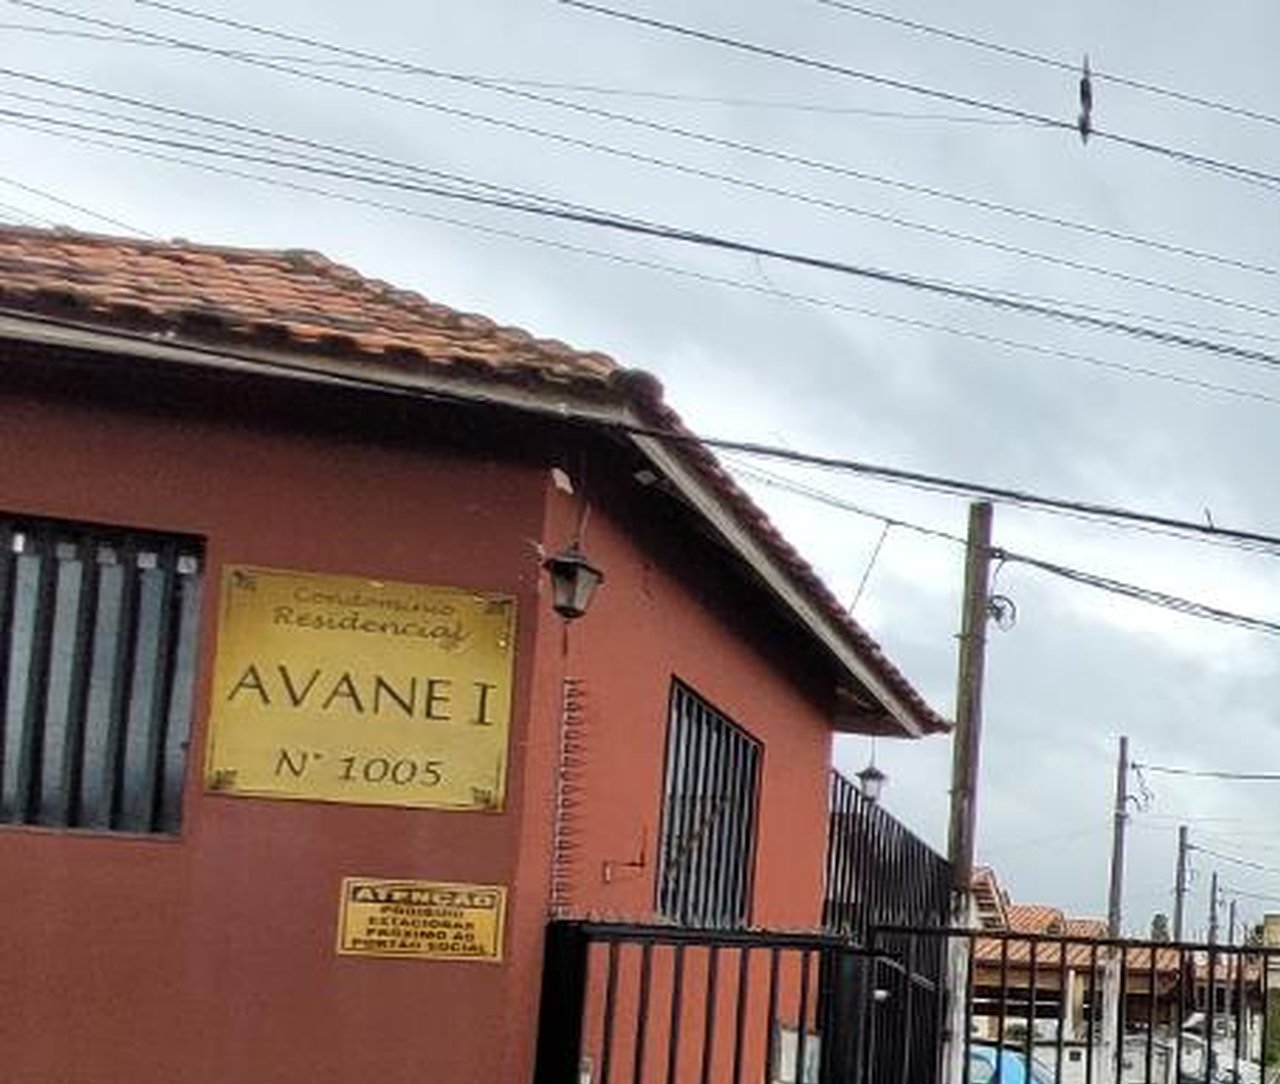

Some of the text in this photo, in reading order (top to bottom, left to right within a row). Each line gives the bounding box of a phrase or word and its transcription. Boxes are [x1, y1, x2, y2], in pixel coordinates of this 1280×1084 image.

[272, 605, 472, 645] Residencial
[227, 664, 497, 727] AVANE I
[338, 753, 444, 787] 1005
[427, 942, 485, 953] SOCIAL
[452, 931, 475, 943] AO
